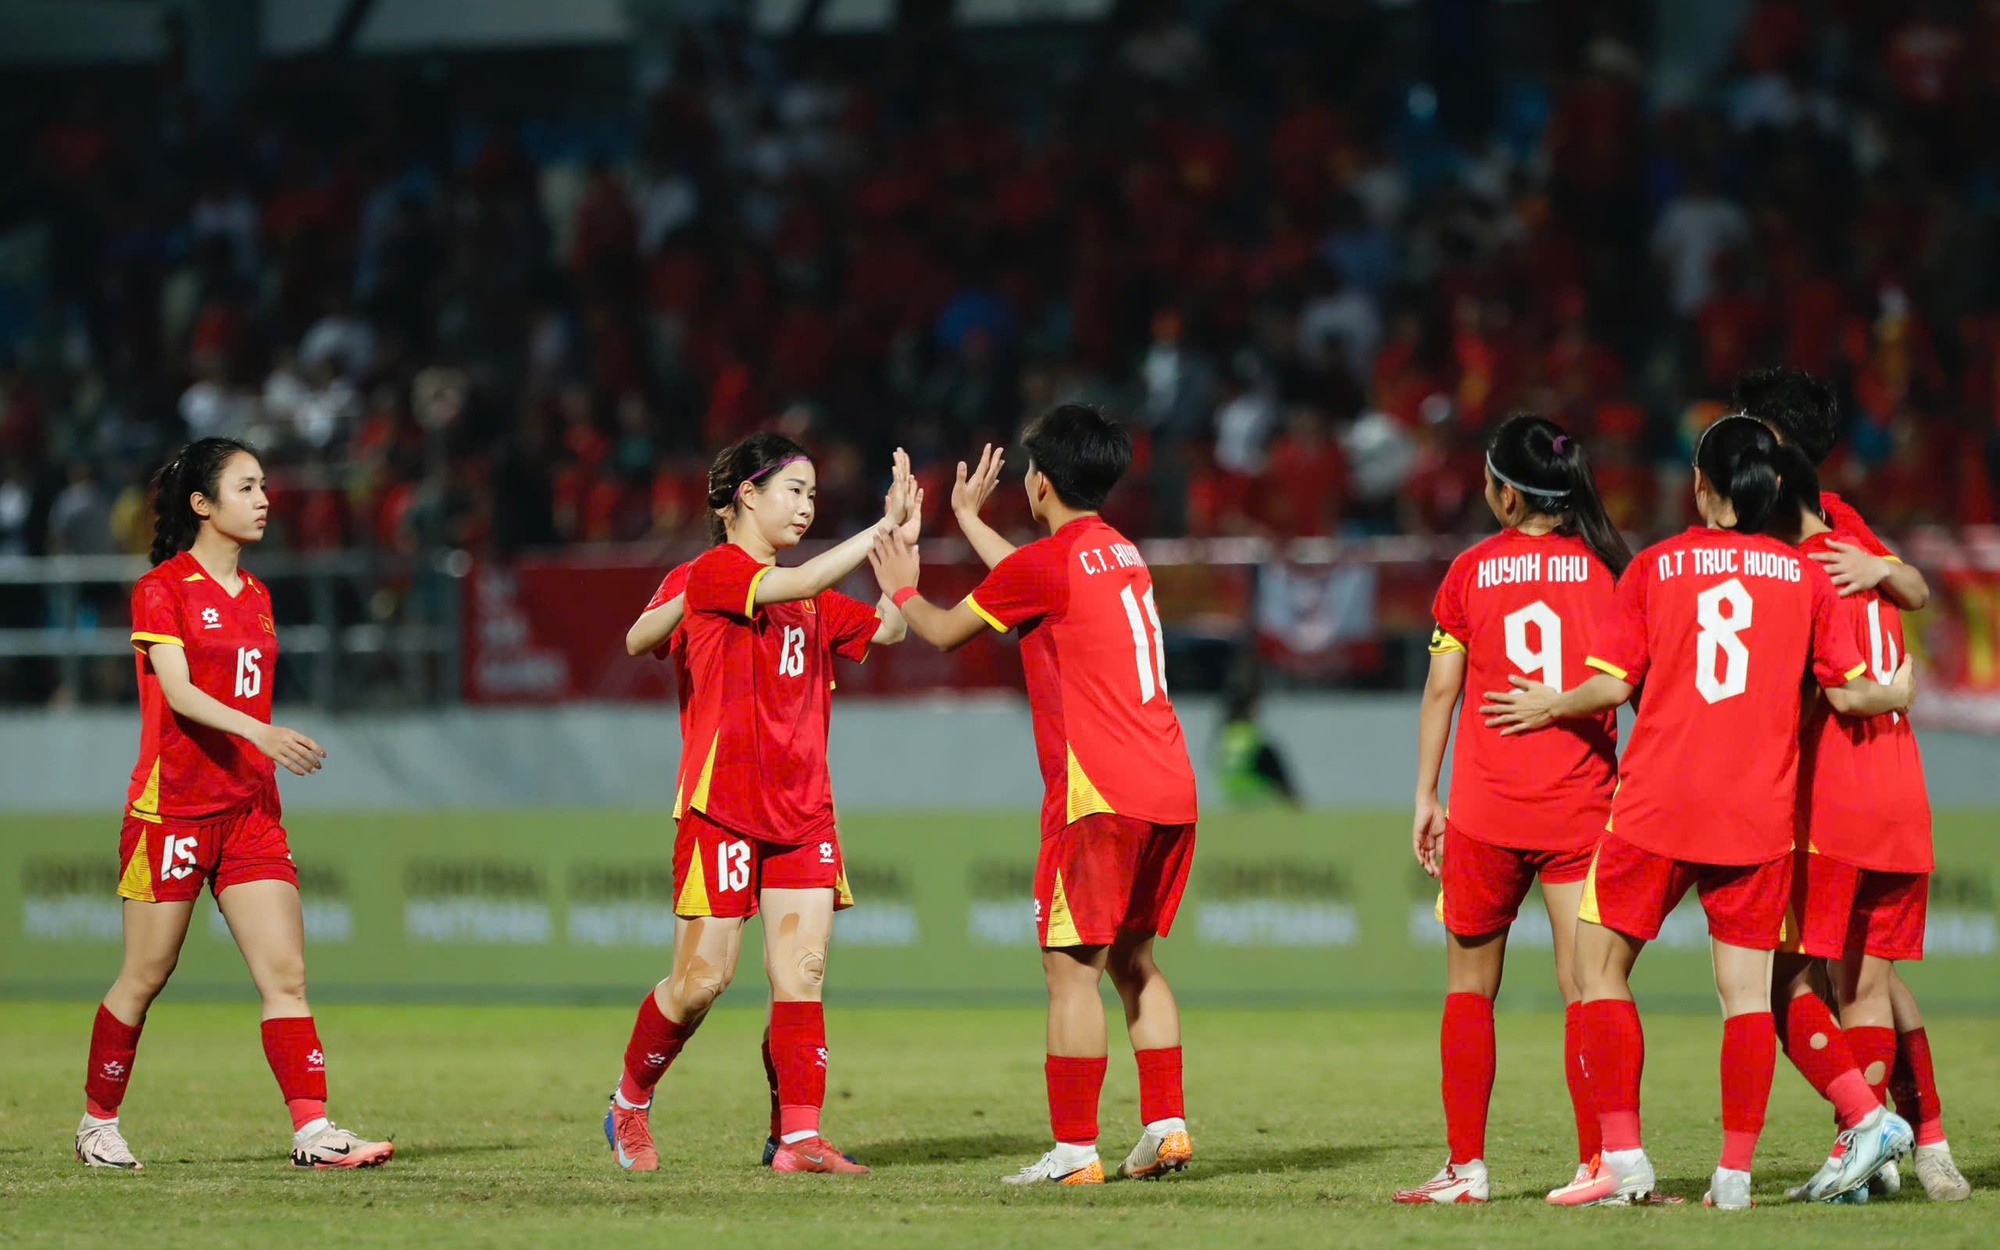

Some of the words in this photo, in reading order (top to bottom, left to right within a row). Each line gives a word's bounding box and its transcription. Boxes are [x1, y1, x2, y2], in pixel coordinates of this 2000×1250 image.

[1079, 548, 1115, 575] C.T.
[1478, 553, 1541, 588] HUYNH
[1548, 555, 1588, 582] NHU
[1658, 551, 1685, 581] N.T
[1692, 549, 1738, 575] TRUC
[1744, 550, 1801, 582] HUONG
[779, 625, 805, 678] 13
[1504, 600, 1563, 694] 9
[1695, 578, 1753, 705] 8
[234, 647, 262, 699] 15
[161, 834, 198, 881] 15
[718, 840, 750, 892] 13
